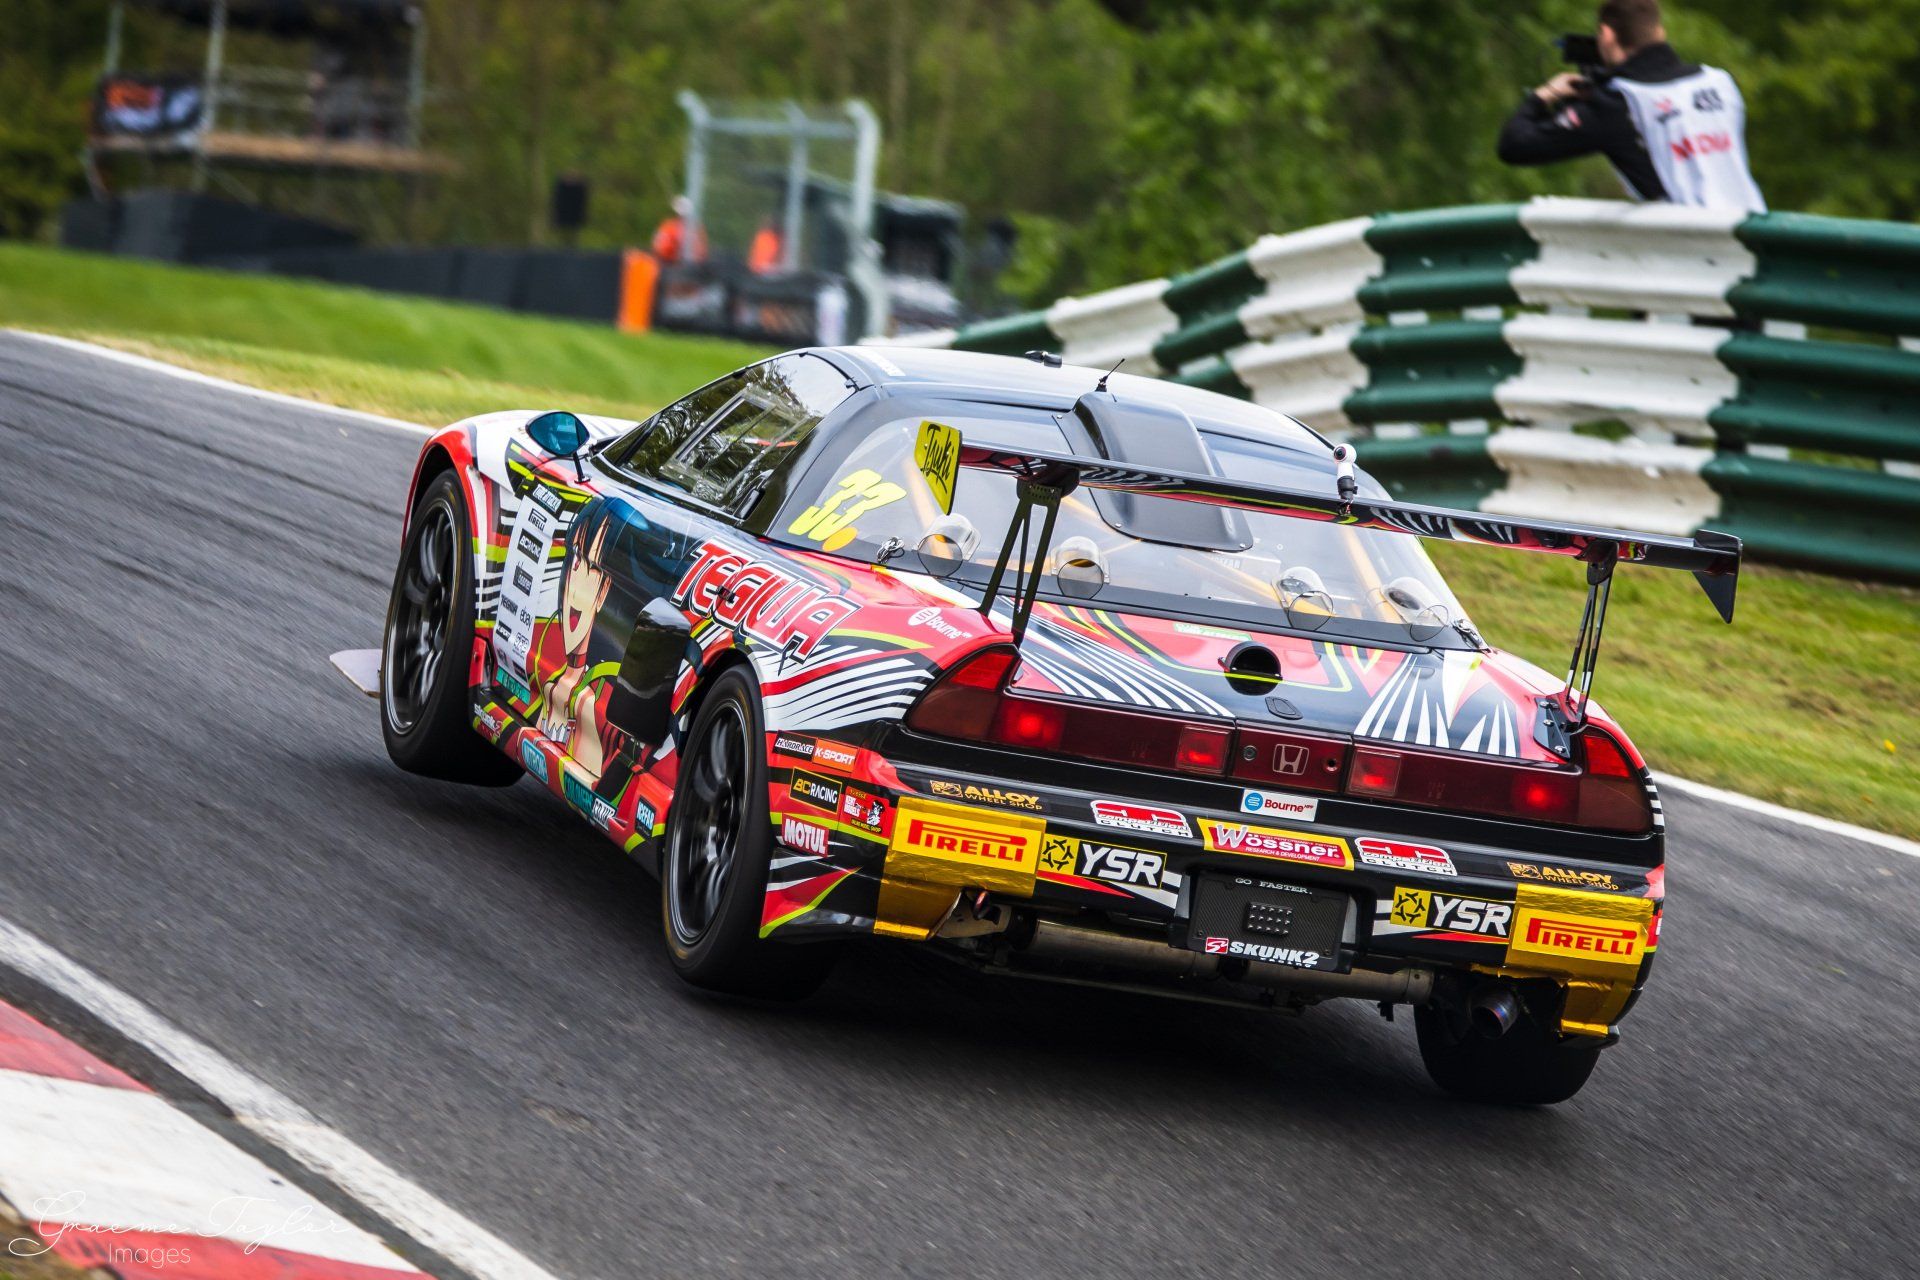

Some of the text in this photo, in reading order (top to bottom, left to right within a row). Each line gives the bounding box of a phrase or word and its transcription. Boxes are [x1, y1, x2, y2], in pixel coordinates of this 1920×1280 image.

[788, 469, 907, 541] 33
[671, 536, 863, 665] TEGIWA
[926, 615, 961, 639] Bourne
[774, 738, 815, 754] HARDRACE
[965, 785, 1039, 806] ALLOY
[965, 793, 1042, 810] WHEEL SHOP
[1264, 799, 1304, 812] Bourne
[784, 818, 827, 854] MOTUL
[1100, 819, 1189, 836] CLUTCH
[908, 819, 1027, 862] PIRELLI
[1216, 824, 1338, 858] Wössner
[1081, 843, 1165, 887] YSR
[1280, 850, 1320, 861] DEVELOPMENT
[1366, 859, 1453, 874] CLUTCH
[1235, 877, 1313, 894] GO FASTER.
[1542, 866, 1612, 884] ALLOY
[1544, 875, 1619, 890] WHEEL SHOP
[1432, 896, 1511, 936] YSR
[1526, 917, 1638, 956] PIRELLI
[1229, 941, 1320, 965] SKUNK2
